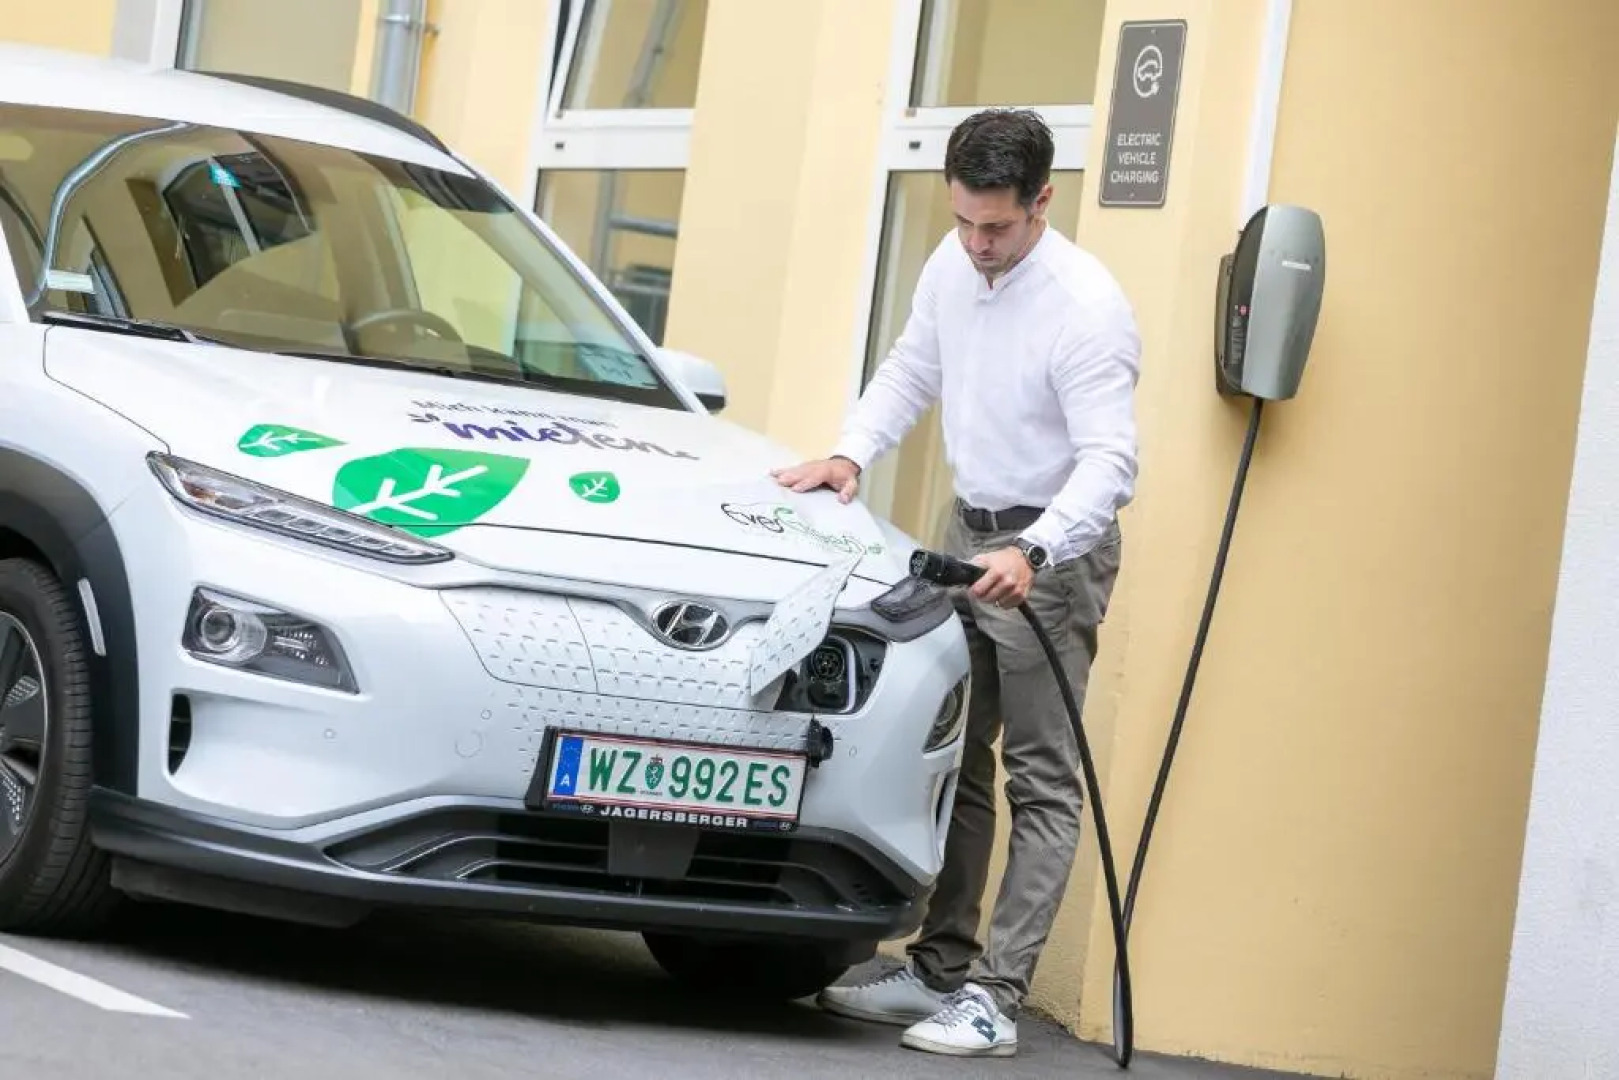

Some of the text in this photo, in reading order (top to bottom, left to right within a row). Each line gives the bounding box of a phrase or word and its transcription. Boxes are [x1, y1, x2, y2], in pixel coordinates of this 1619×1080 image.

[1117, 133, 1162, 146] ELECTRIC
[1118, 151, 1157, 165] VEHICLE
[1110, 170, 1160, 184] CHARGING
[589, 747, 643, 794] WZ
[560, 777, 570, 787] A
